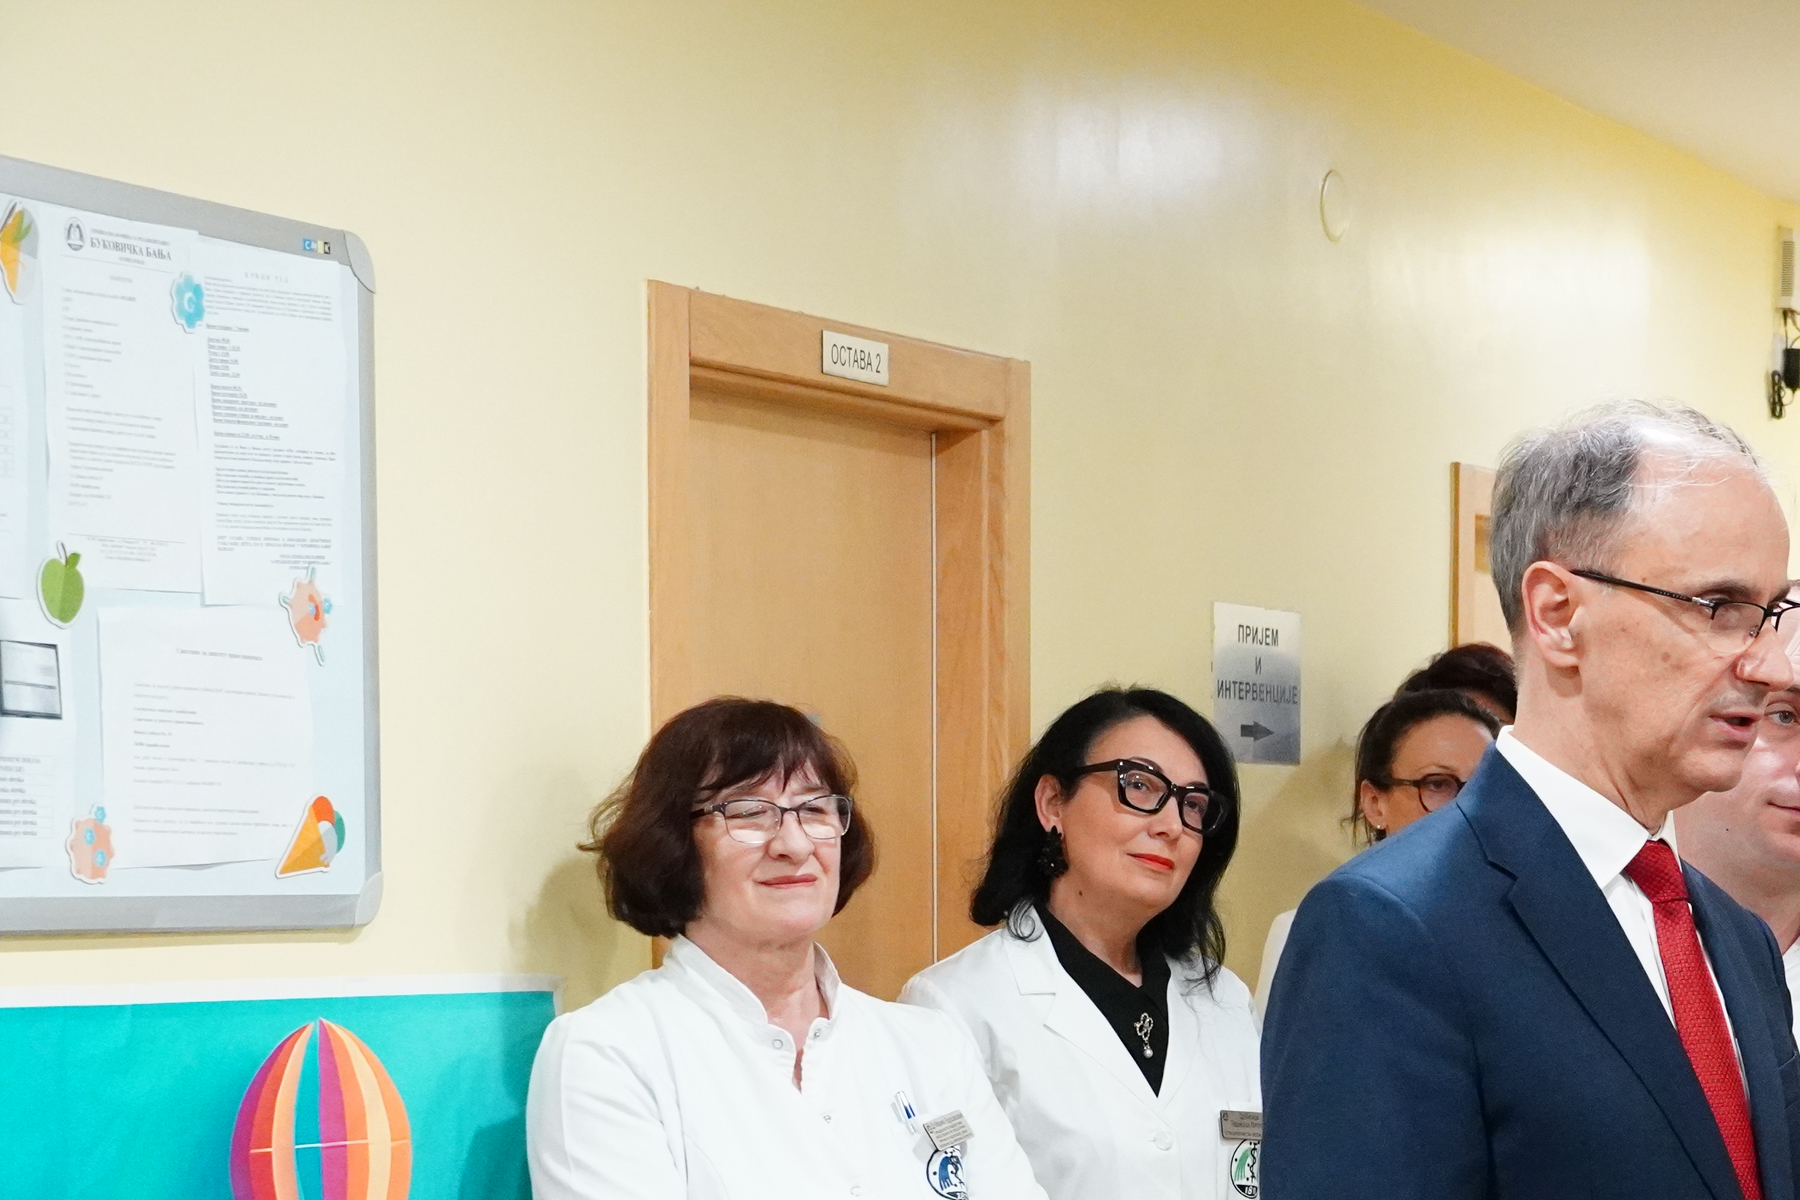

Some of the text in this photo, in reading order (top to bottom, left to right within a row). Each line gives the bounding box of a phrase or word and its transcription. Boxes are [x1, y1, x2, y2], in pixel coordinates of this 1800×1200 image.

[90, 237, 144, 256] БУКОВИЧКА
[146, 247, 172, 261] БАЊА
[831, 344, 881, 373] ОСТАВА 2
[1238, 624, 1278, 646] ПРИЈЕМ
[1255, 656, 1262, 675] И
[1217, 679, 1298, 705] ИНТЕРВЕНЦИЈЕ
